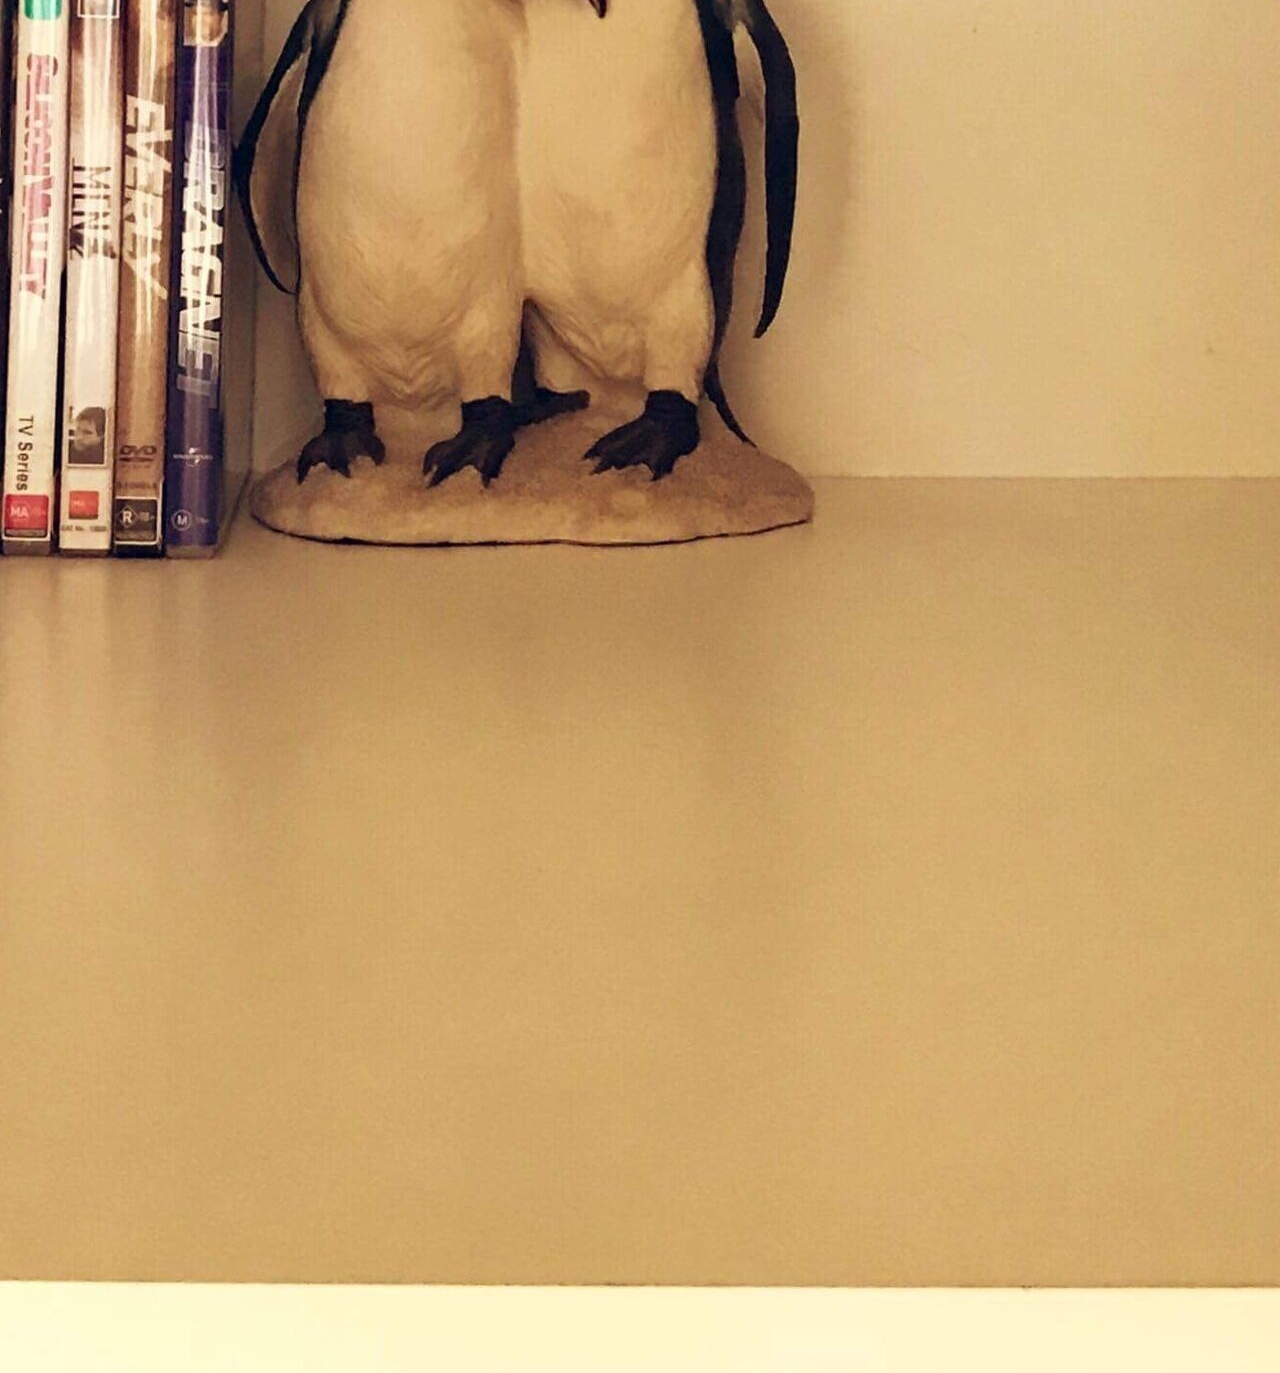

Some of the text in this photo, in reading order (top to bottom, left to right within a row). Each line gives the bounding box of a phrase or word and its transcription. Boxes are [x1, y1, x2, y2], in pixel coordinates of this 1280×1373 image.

[121, 94, 174, 300] EVERLY
[175, 121, 225, 409] DRAGNET
[16, 414, 35, 492] TV Series
